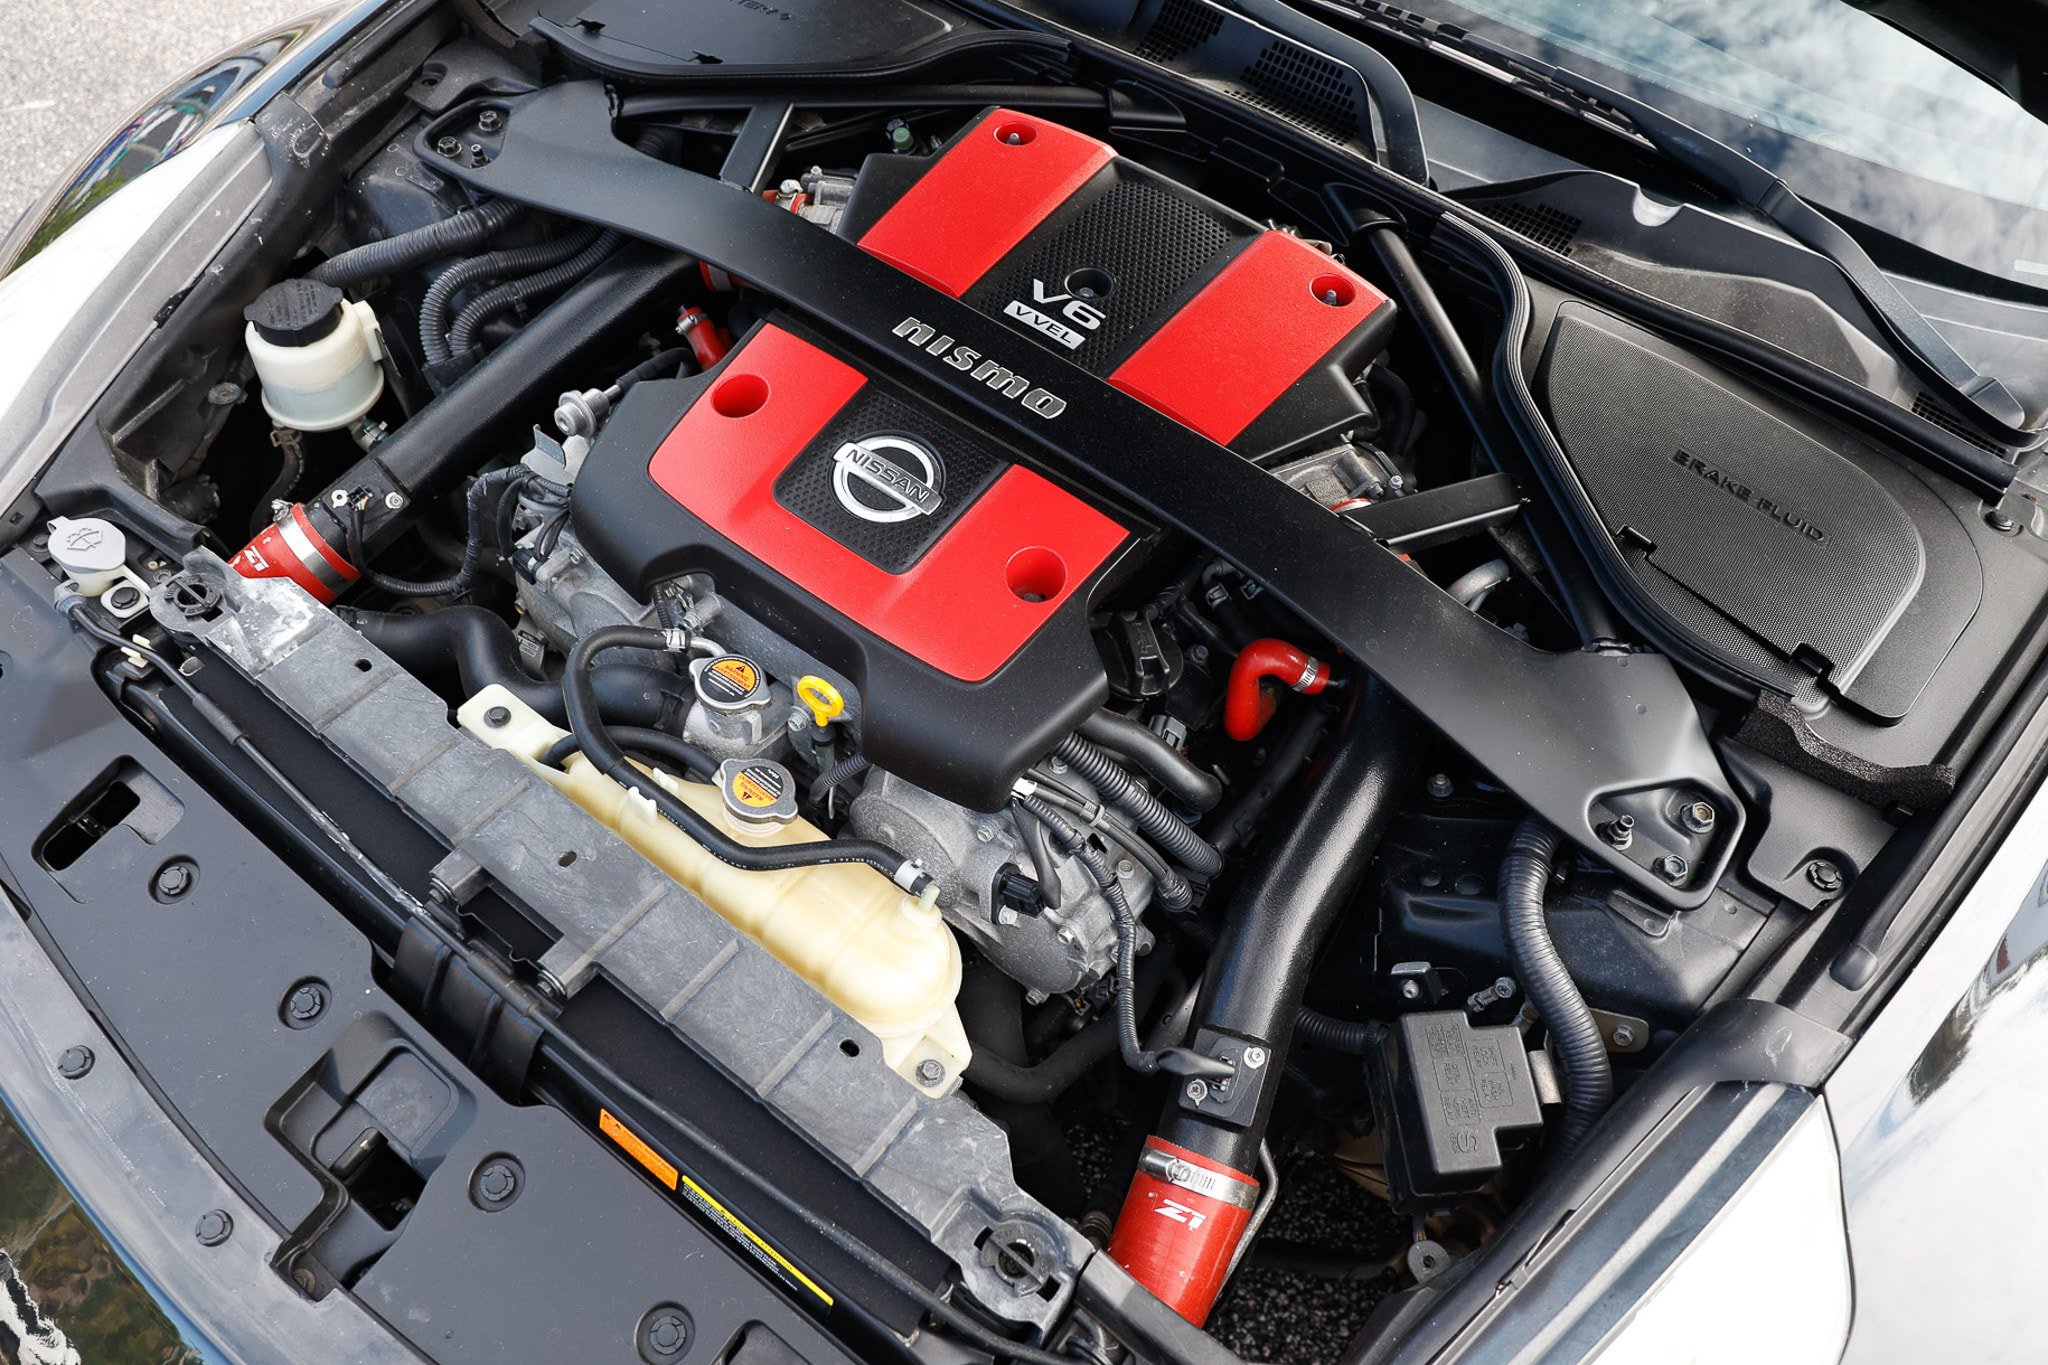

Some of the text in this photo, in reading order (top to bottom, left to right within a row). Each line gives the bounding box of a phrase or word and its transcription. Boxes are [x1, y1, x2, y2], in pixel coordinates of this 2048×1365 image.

[1015, 305, 1071, 344] VVEL
[1033, 278, 1107, 330] V6
[845, 448, 930, 503] NISSAN
[1673, 449, 1825, 541] BRAKE FLUID
